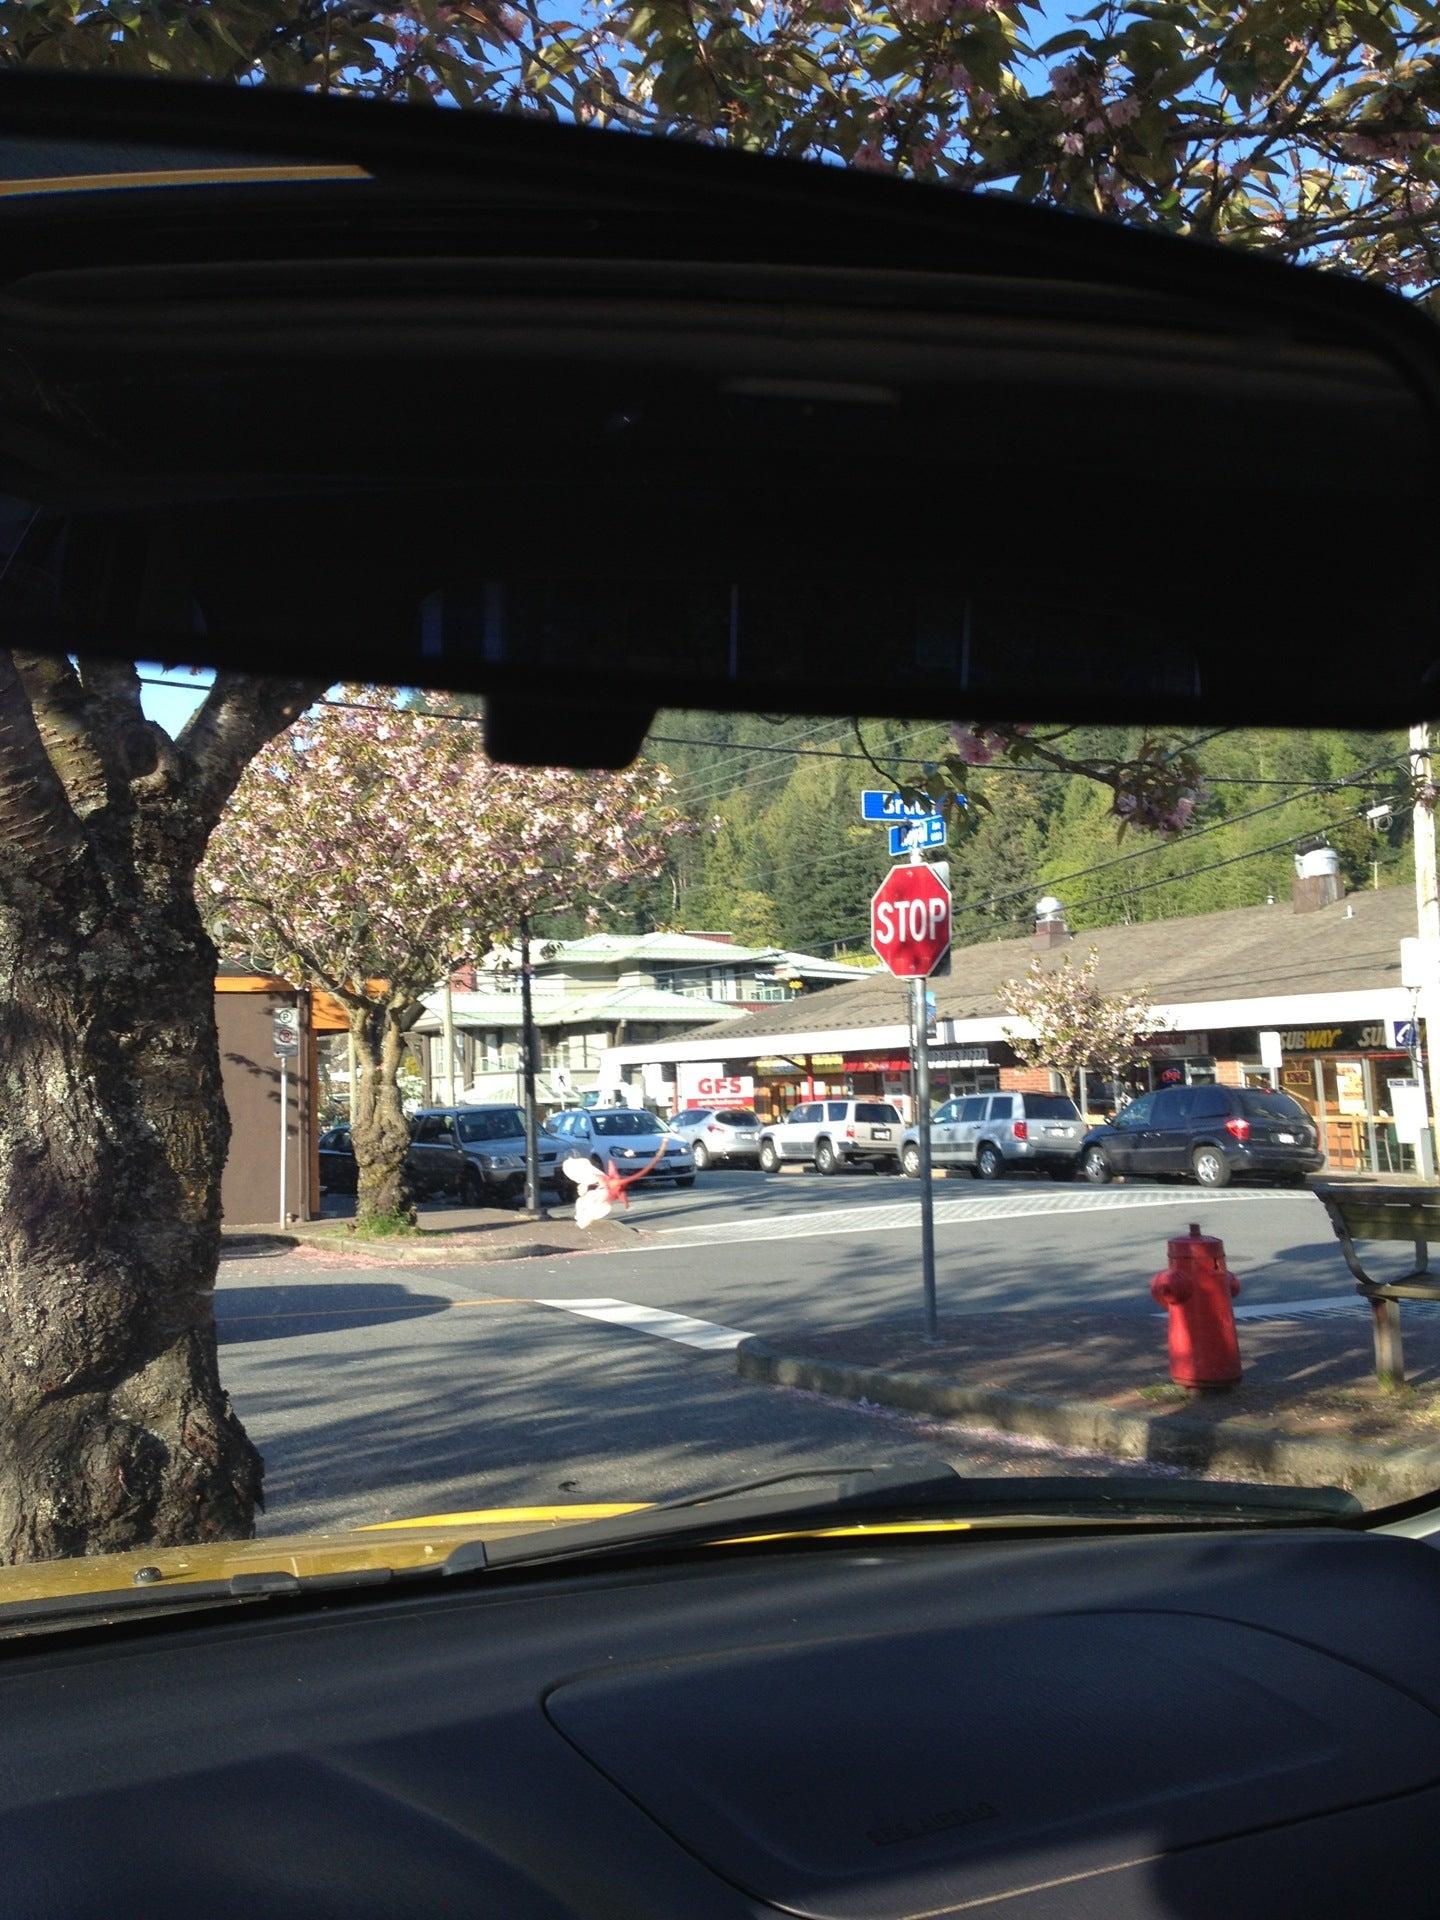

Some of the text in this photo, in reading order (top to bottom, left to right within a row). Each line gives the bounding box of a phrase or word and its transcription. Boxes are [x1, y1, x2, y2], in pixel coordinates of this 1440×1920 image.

[876, 898, 946, 944] STOP
[1280, 1028, 1342, 1050] SUBWAY
[698, 1075, 741, 1094] GFS
